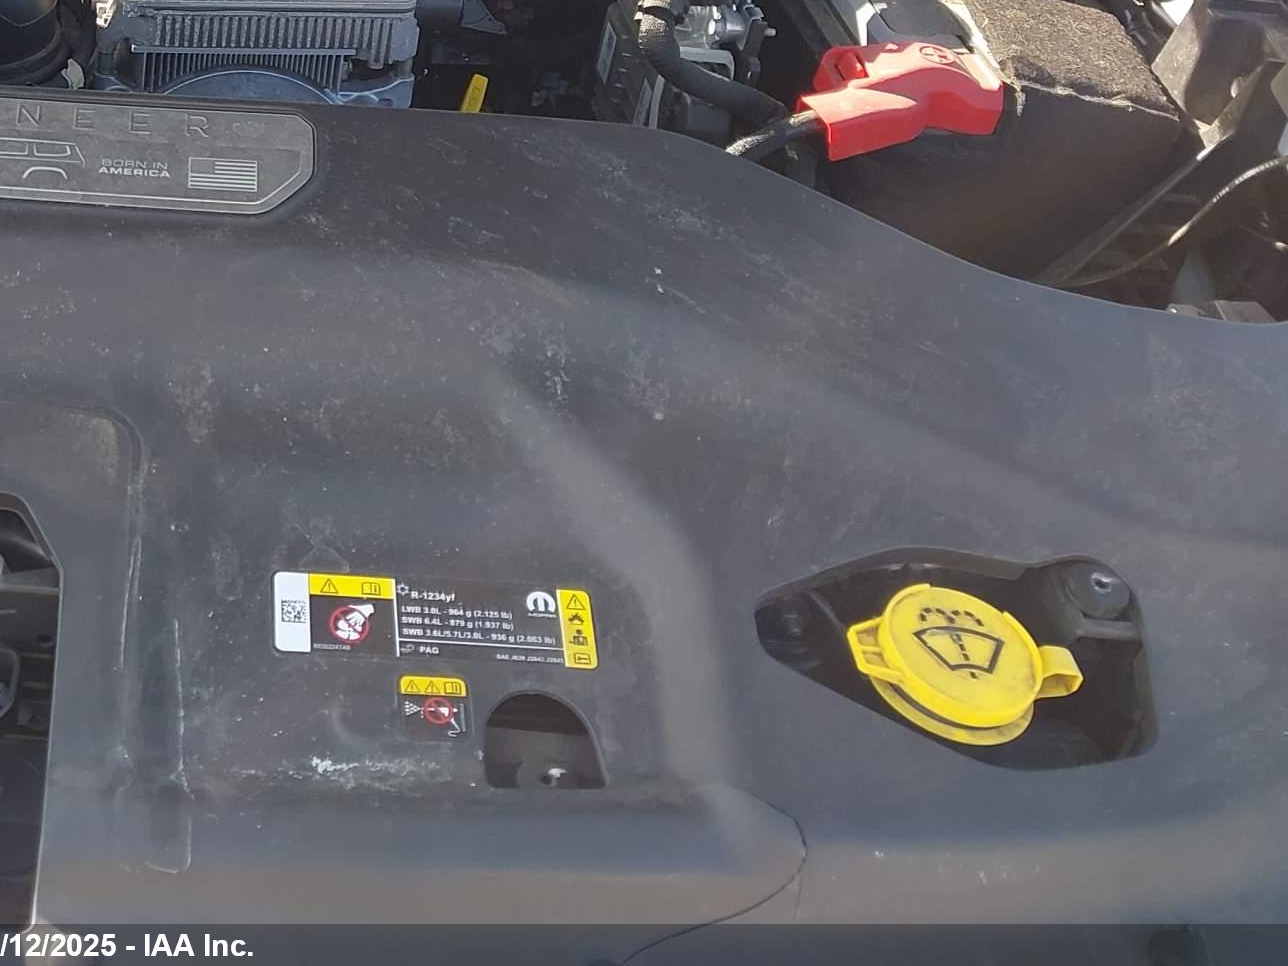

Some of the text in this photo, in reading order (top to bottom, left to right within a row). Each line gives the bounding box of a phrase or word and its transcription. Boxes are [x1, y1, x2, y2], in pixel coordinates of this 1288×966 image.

[102, 158, 168, 170] BORN IN
[98, 166, 171, 179] AMERICA
[411, 591, 456, 603] R-1234yf
[401, 605, 421, 614] LWB
[465, 610, 472, 618] g
[401, 616, 423, 625] SWB
[467, 621, 473, 629] g
[402, 628, 424, 636] SWB
[508, 635, 515, 644] g
[419, 646, 440, 655] PAG
